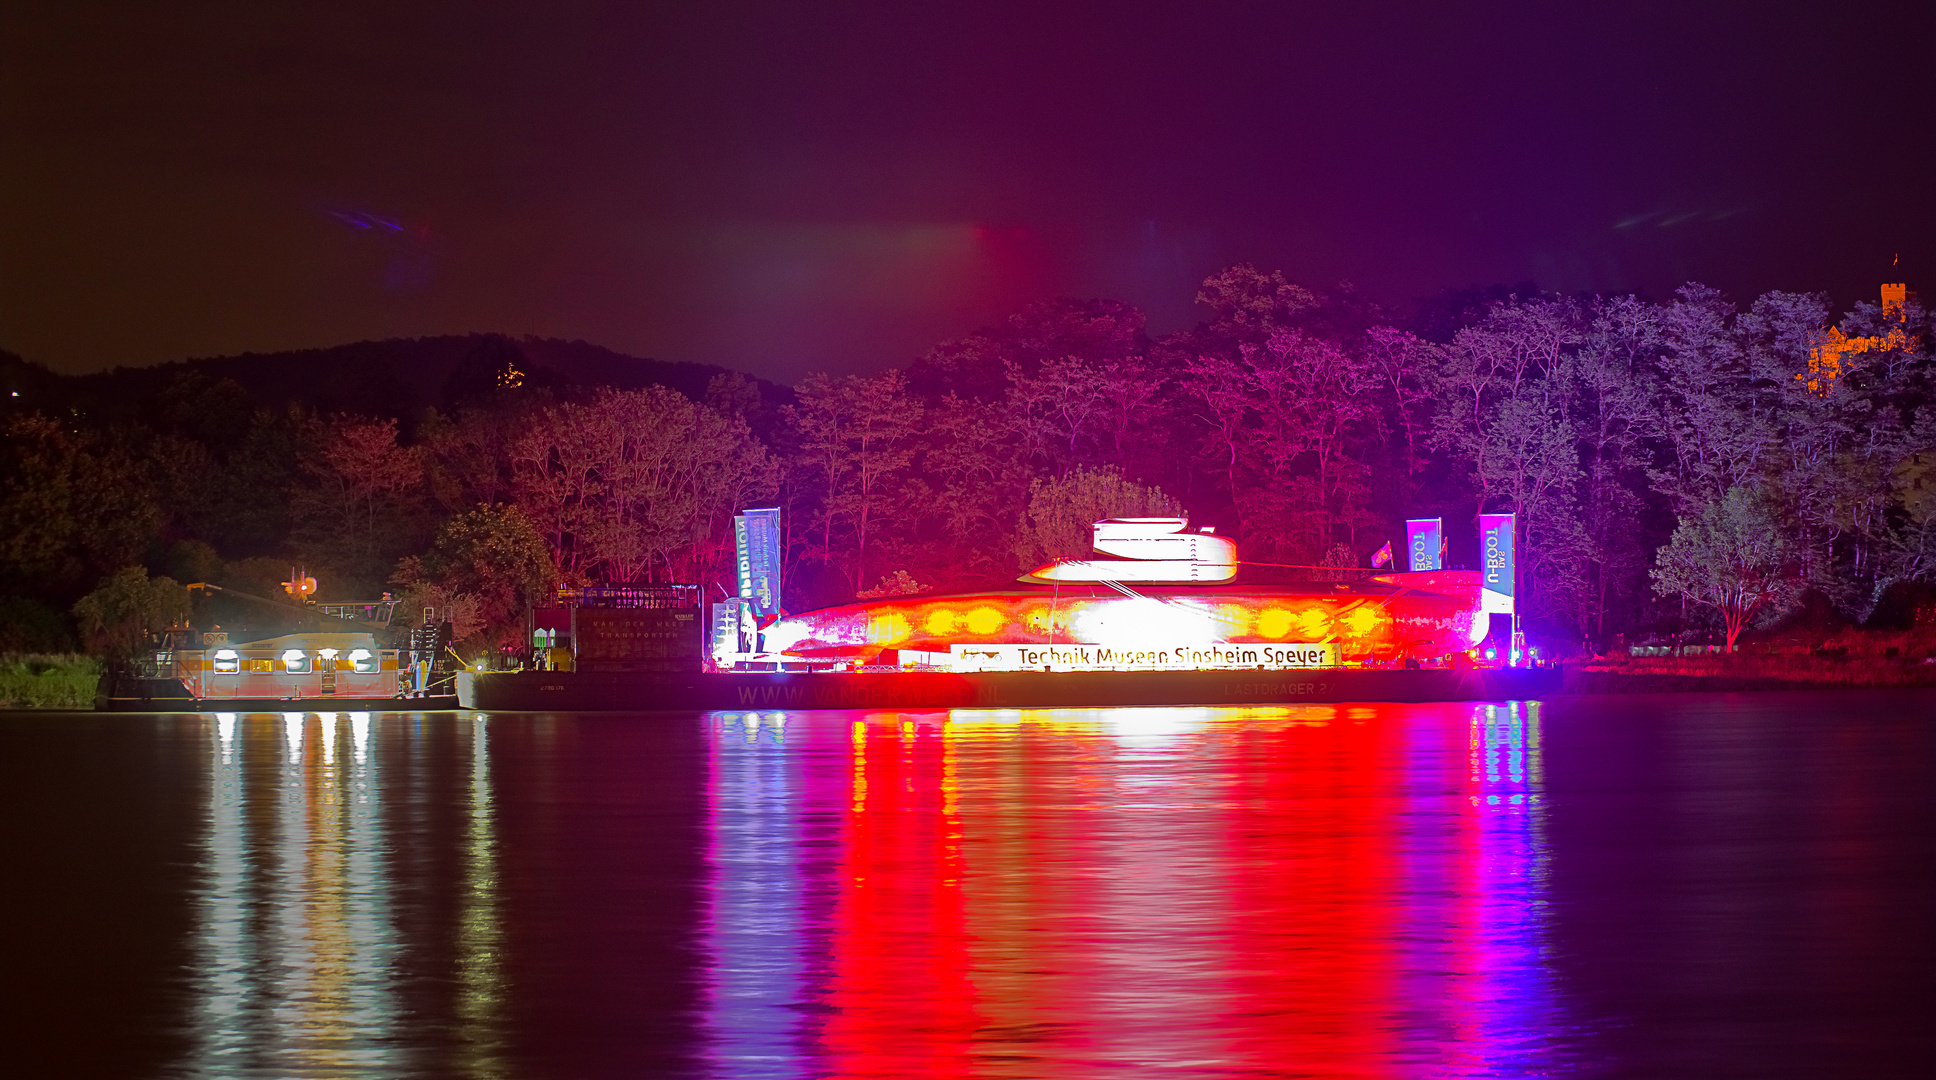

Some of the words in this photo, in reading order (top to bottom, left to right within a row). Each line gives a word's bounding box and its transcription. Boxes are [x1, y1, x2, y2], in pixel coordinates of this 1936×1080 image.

[1018, 647, 1090, 665] Technik
[1096, 648, 1169, 665] Museen
[1175, 646, 1258, 664] Sinsheim
[1264, 646, 1326, 667] Speyer
[738, 685, 1008, 705] WWW.VANDERWEES.NL
[1224, 683, 1315, 696] LASTDRAGER
